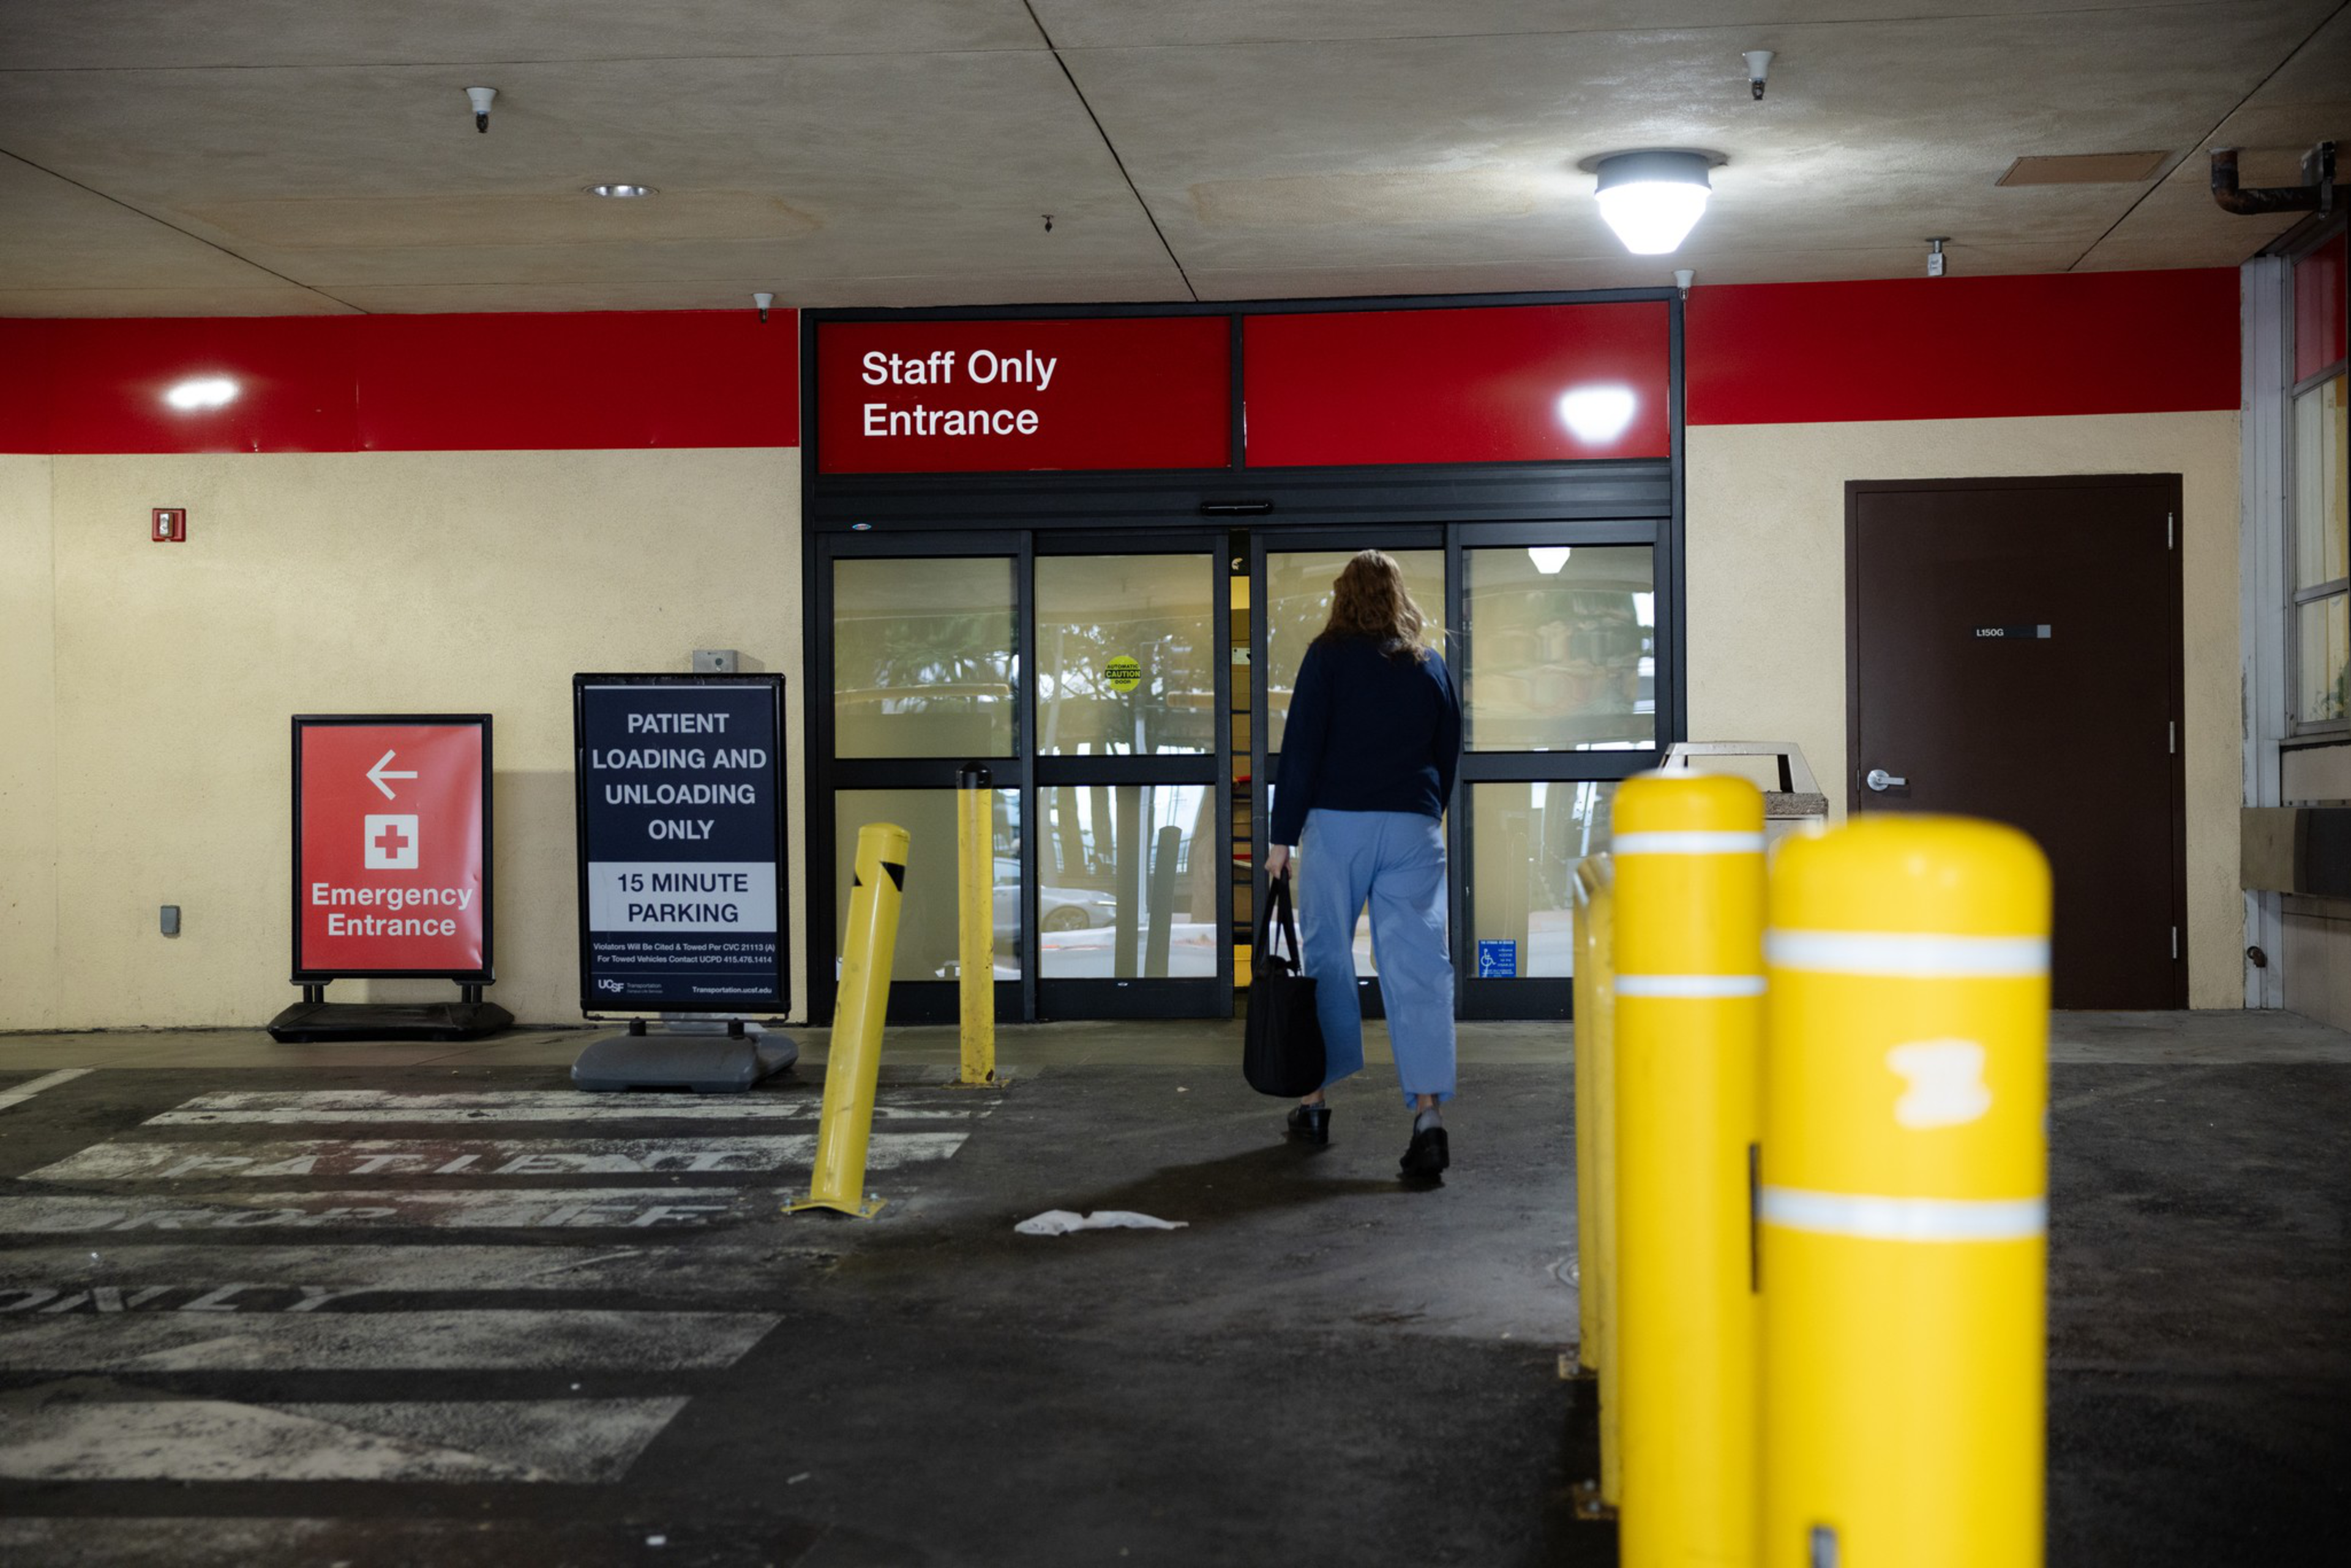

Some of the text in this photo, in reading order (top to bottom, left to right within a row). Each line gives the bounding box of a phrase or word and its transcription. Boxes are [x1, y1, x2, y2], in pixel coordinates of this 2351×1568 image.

[862, 350, 1057, 391] Staff Only
[864, 403, 1039, 437] Entrance
[1976, 628, 2004, 637] L150G
[628, 713, 730, 733] PATIENT
[592, 748, 767, 769] LOADING AND
[606, 784, 756, 805] UNLOADING
[648, 819, 714, 840] ONLY
[617, 873, 748, 892] 15 MINUTE
[312, 882, 473, 910] Emergency
[628, 903, 738, 923] PARKING
[328, 913, 456, 936] Entrance
[765, 943, 776, 952] (A)
[598, 979, 624, 992] UCSF
